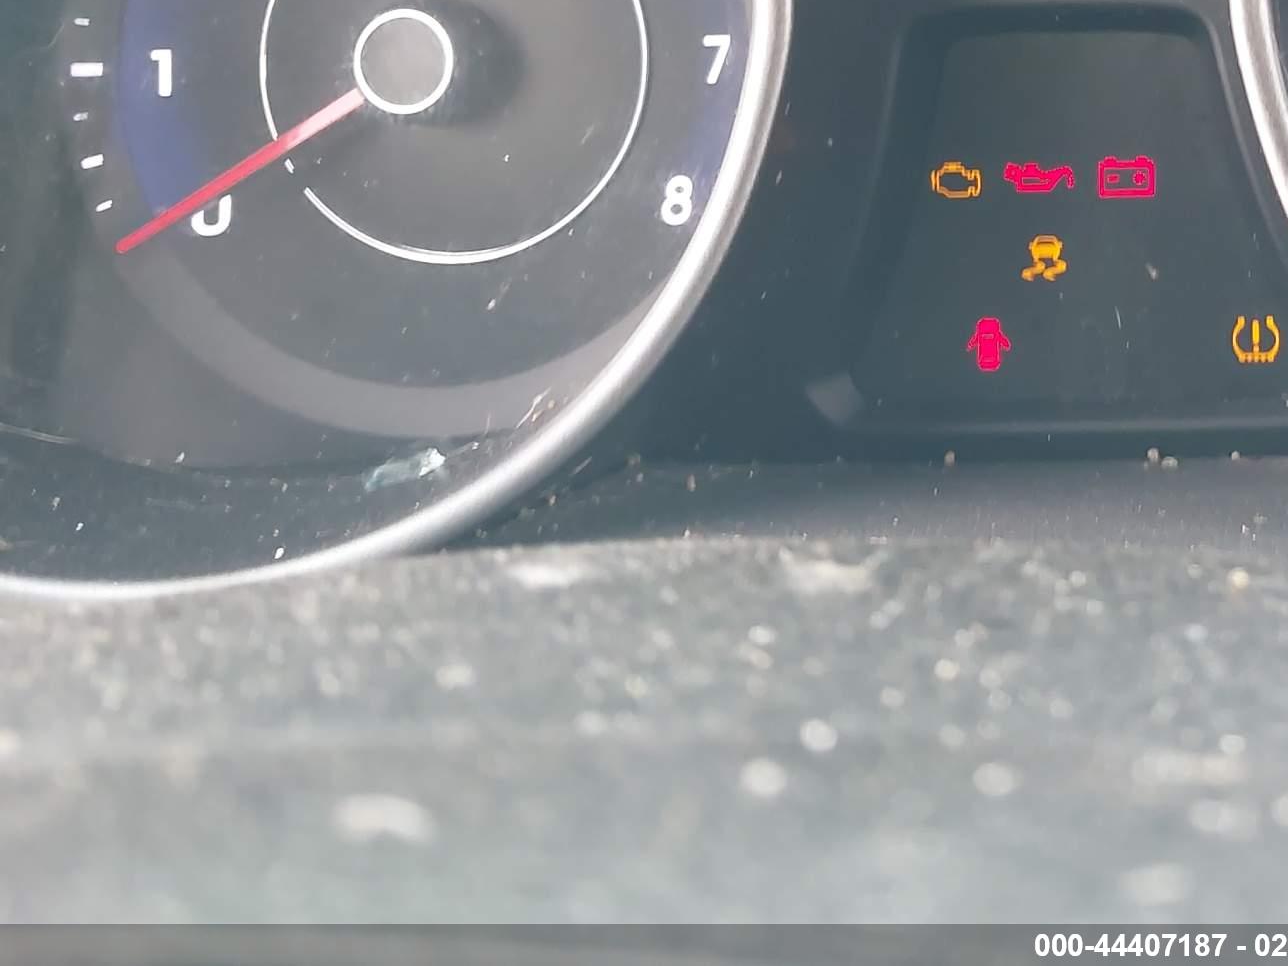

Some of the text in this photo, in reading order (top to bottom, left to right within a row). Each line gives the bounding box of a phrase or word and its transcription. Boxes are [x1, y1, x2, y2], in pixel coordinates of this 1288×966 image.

[150, 49, 173, 97] 1
[702, 33, 731, 85] 7
[660, 174, 693, 226] 8
